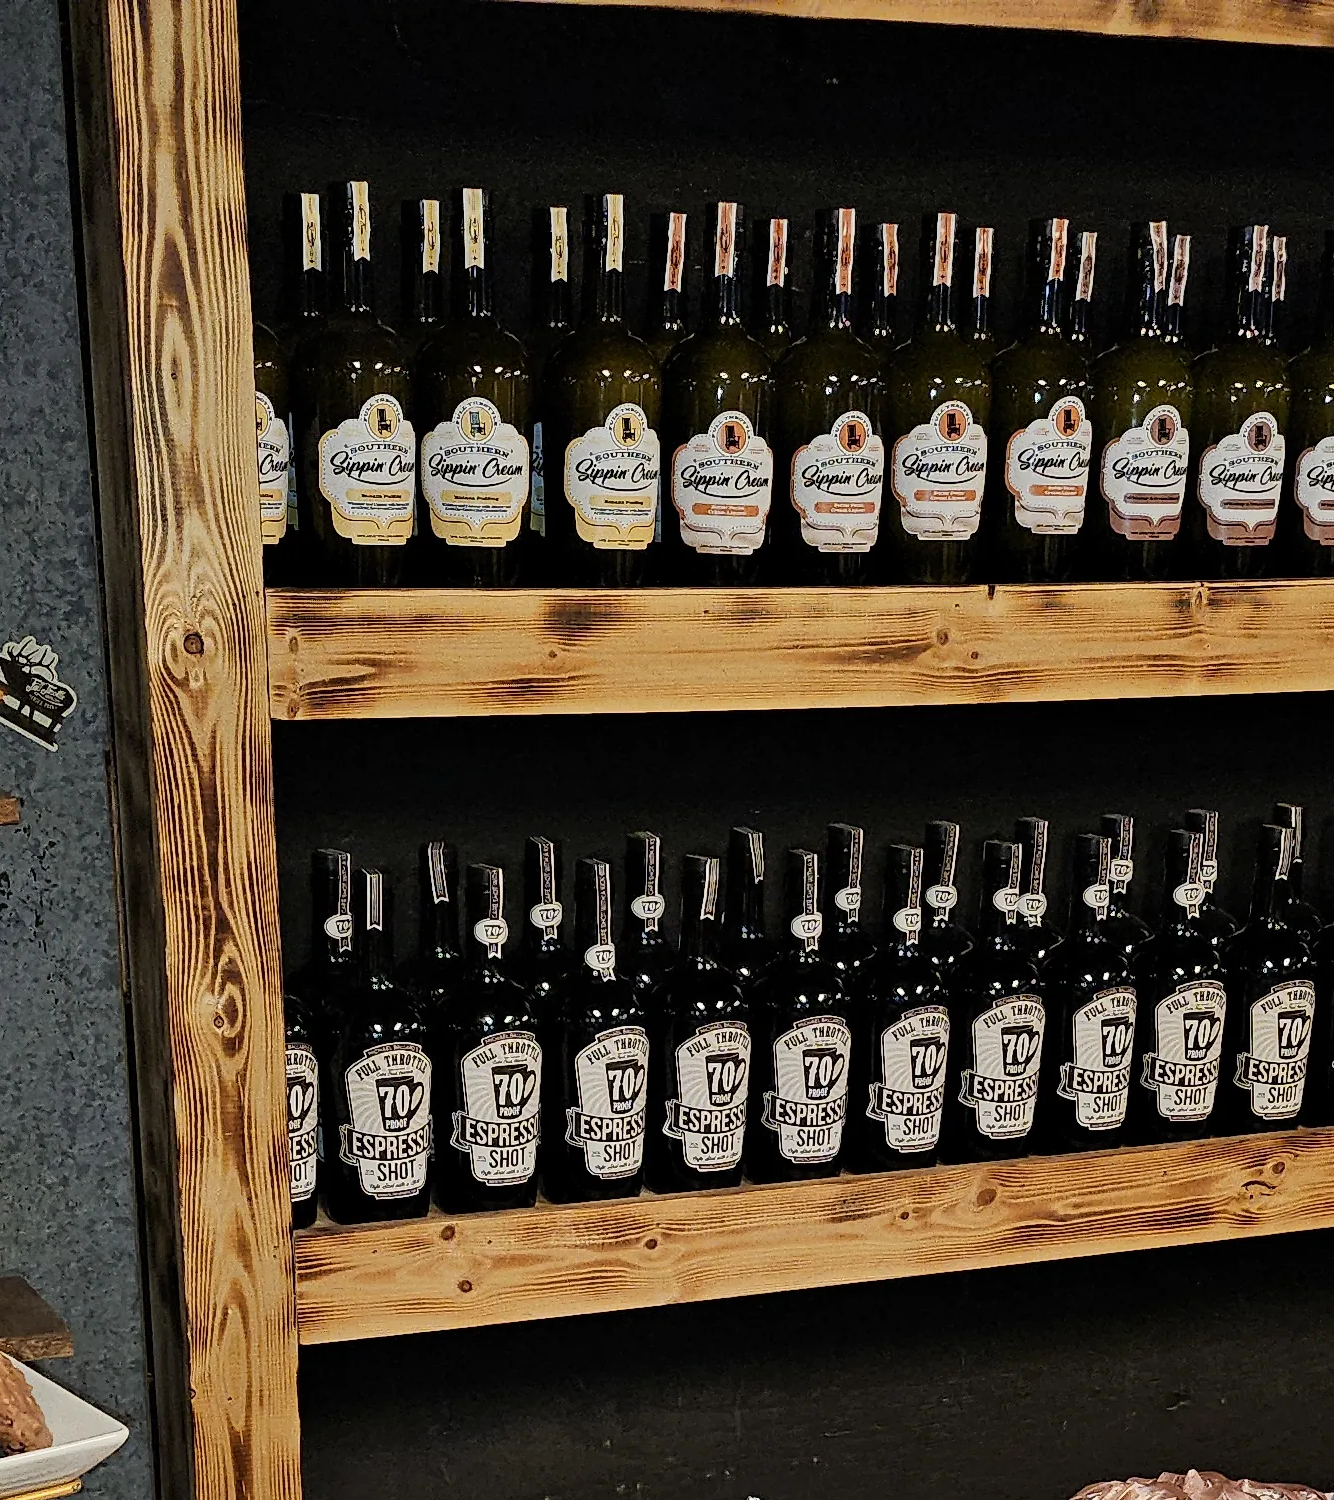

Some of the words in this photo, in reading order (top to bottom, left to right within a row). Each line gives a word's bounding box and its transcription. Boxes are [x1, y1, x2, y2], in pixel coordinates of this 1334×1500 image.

[350, 443, 409, 455] SOUTHERN
[444, 445, 510, 457] SOUTHERN
[595, 450, 652, 463] SOUTHERN
[920, 446, 978, 456] SOUTHERN
[482, 458, 523, 478] Cream
[698, 458, 759, 470] SOUTHERN
[820, 457, 877, 468] SOUTHERN
[734, 472, 769, 489] Cream
[1084, 1004, 1107, 1021] FULL
[1166, 996, 1189, 1013] FULL
[1260, 996, 1284, 1013] FULL
[982, 1011, 1008, 1028] FULL
[784, 1035, 808, 1050] FULL
[891, 1024, 916, 1041] FULL
[1103, 1026, 1126, 1057] 70
[1185, 1019, 1208, 1049] 70
[1279, 1019, 1302, 1049] 70
[472, 1050, 497, 1068] FULL
[586, 1045, 607, 1065] FULL
[686, 1041, 711, 1057] FULL
[1004, 1034, 1029, 1065] 70
[355, 1061, 380, 1081] FULL
[805, 1055, 832, 1086] 70
[912, 1046, 936, 1078] 70
[1005, 1065, 1026, 1074] PROOF
[707, 1062, 734, 1093] 70
[915, 1076, 933, 1086] PROOF
[1155, 1061, 1218, 1086] ESPRESS
[1248, 1061, 1306, 1084] ESPRESS
[494, 1073, 524, 1105] 70
[608, 1068, 634, 1101] 70
[808, 1087, 828, 1097] PROOF
[973, 1077, 1039, 1101] ESPRESS
[1268, 1085, 1299, 1103] SHOT
[379, 1085, 410, 1117] 70
[613, 1101, 632, 1111] PROOF
[712, 1093, 731, 1103] PROOF
[881, 1089, 944, 1114] ESPRESS
[1093, 1092, 1123, 1114] SHOT
[1174, 1087, 1208, 1106] SHOT
[499, 1106, 520, 1116] PROOF
[679, 1104, 746, 1132] ESPRESS
[775, 1098, 846, 1125] ESPRESSO
[994, 1102, 1027, 1123] SHOT
[386, 1119, 407, 1129] PROOF
[466, 1114, 539, 1146] ESPRESSO
[580, 1113, 644, 1140] ESPRESS
[903, 1115, 936, 1136] SHOT
[353, 1125, 428, 1159] ESPRESSO
[701, 1135, 736, 1154] SHOT
[796, 1126, 832, 1147] SHOT
[489, 1147, 527, 1168] SHOT
[604, 1144, 637, 1162] SHOT
[378, 1160, 416, 1181] SHOT
